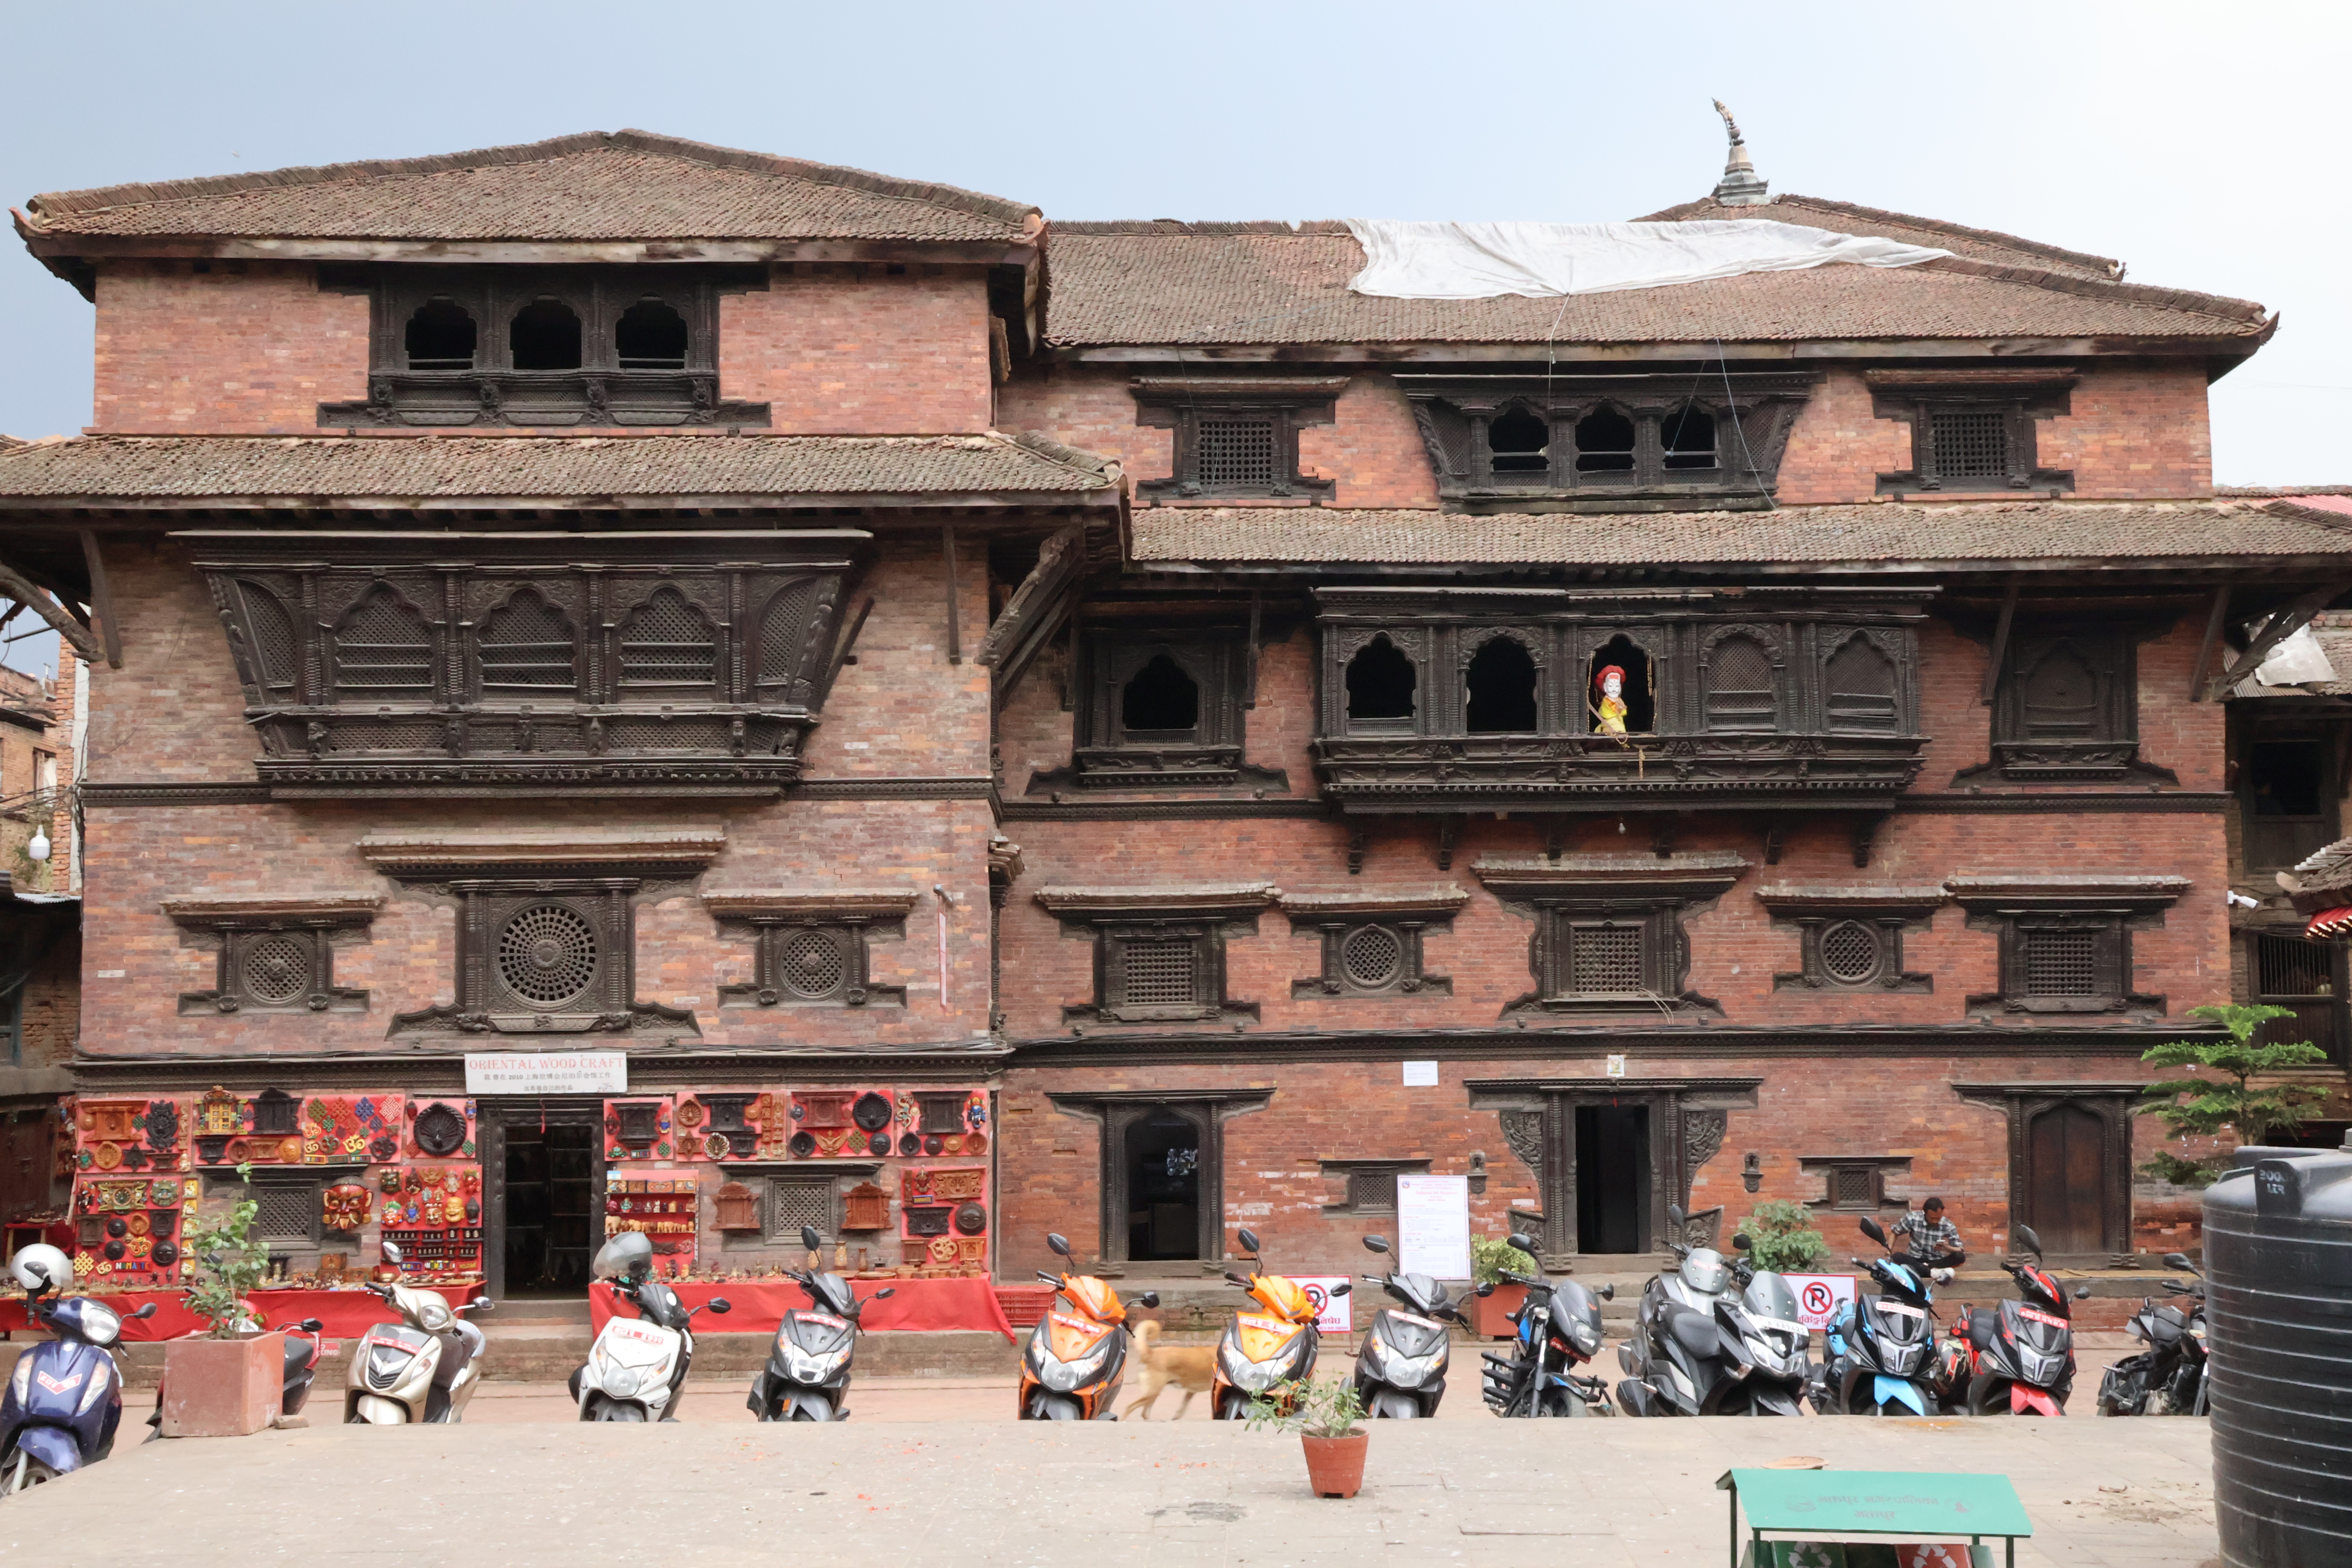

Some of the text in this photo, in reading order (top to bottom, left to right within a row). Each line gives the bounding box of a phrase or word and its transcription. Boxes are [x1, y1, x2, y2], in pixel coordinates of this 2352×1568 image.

[470, 1058, 623, 1069] ORIENTAL WOOD CRAFT
